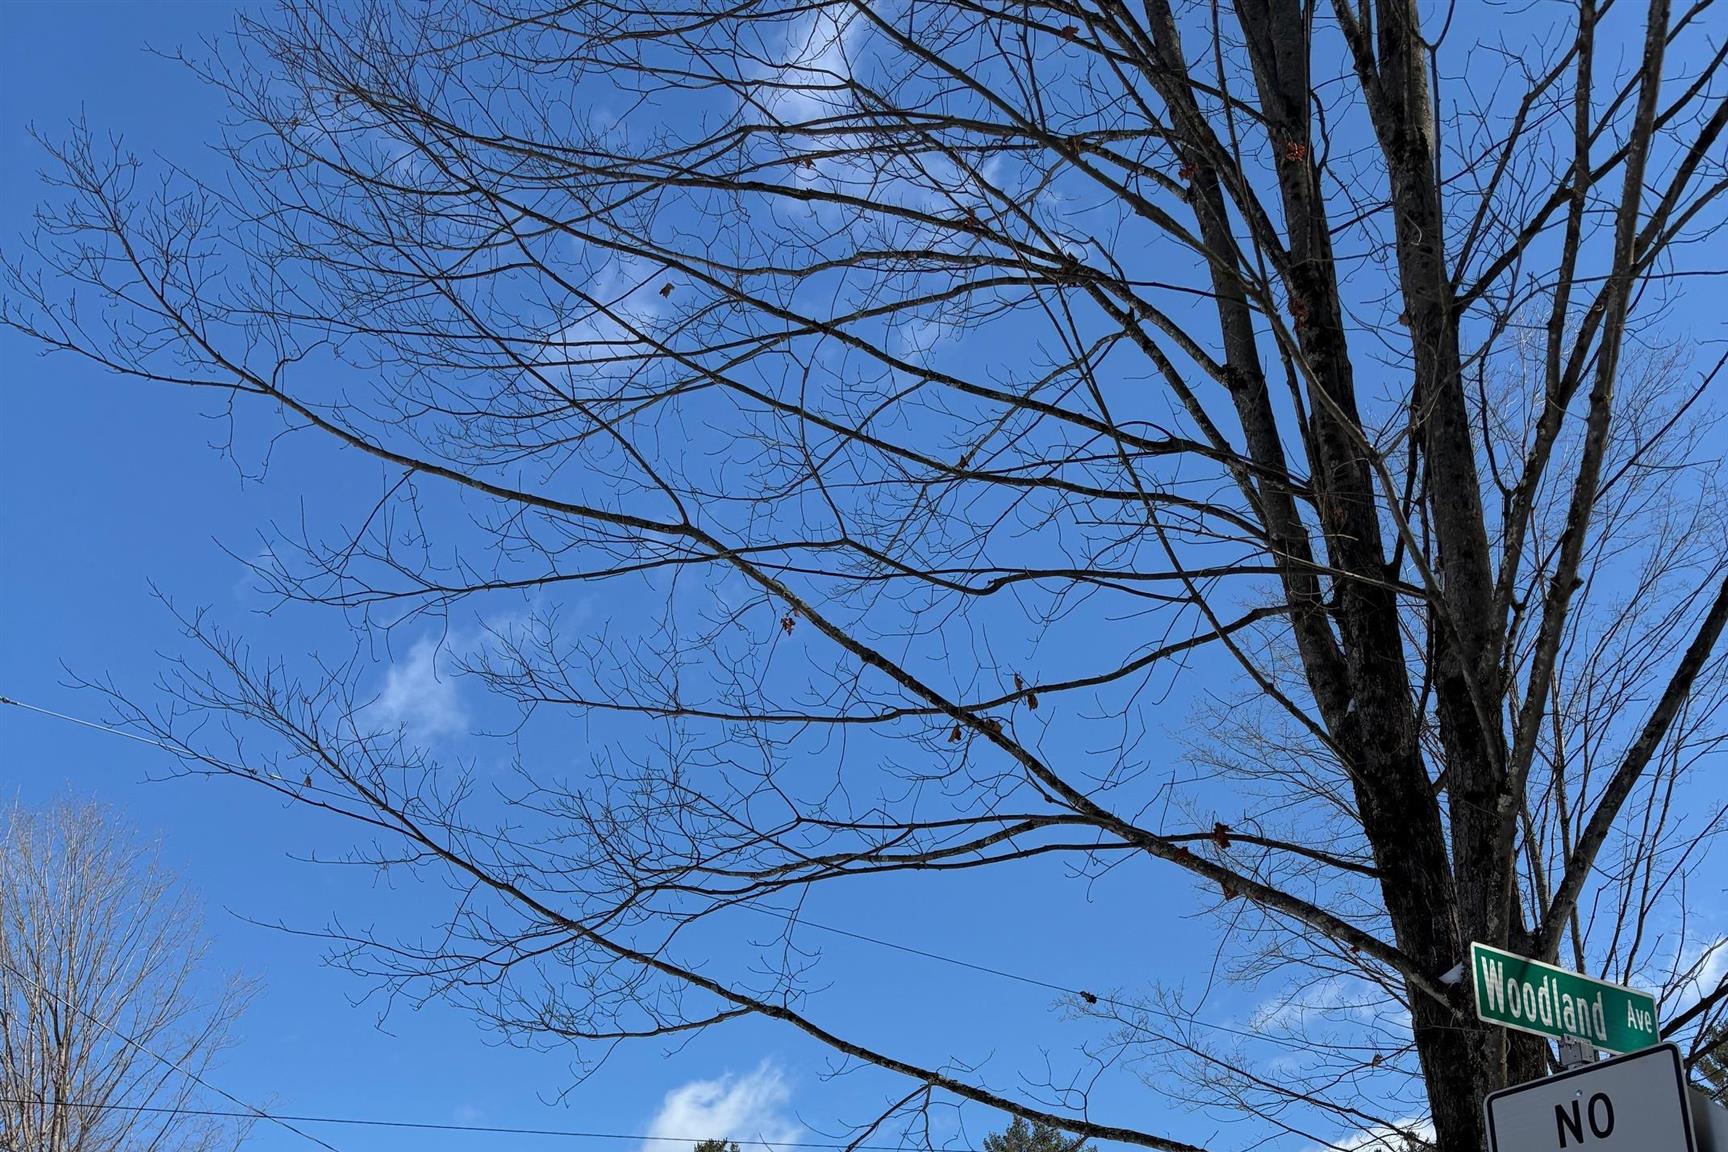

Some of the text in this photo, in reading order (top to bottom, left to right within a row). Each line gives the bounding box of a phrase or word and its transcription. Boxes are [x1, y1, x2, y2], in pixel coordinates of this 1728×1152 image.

[1481, 955, 1653, 1042] Woodland Ave
[1555, 1093, 1615, 1148] NO
